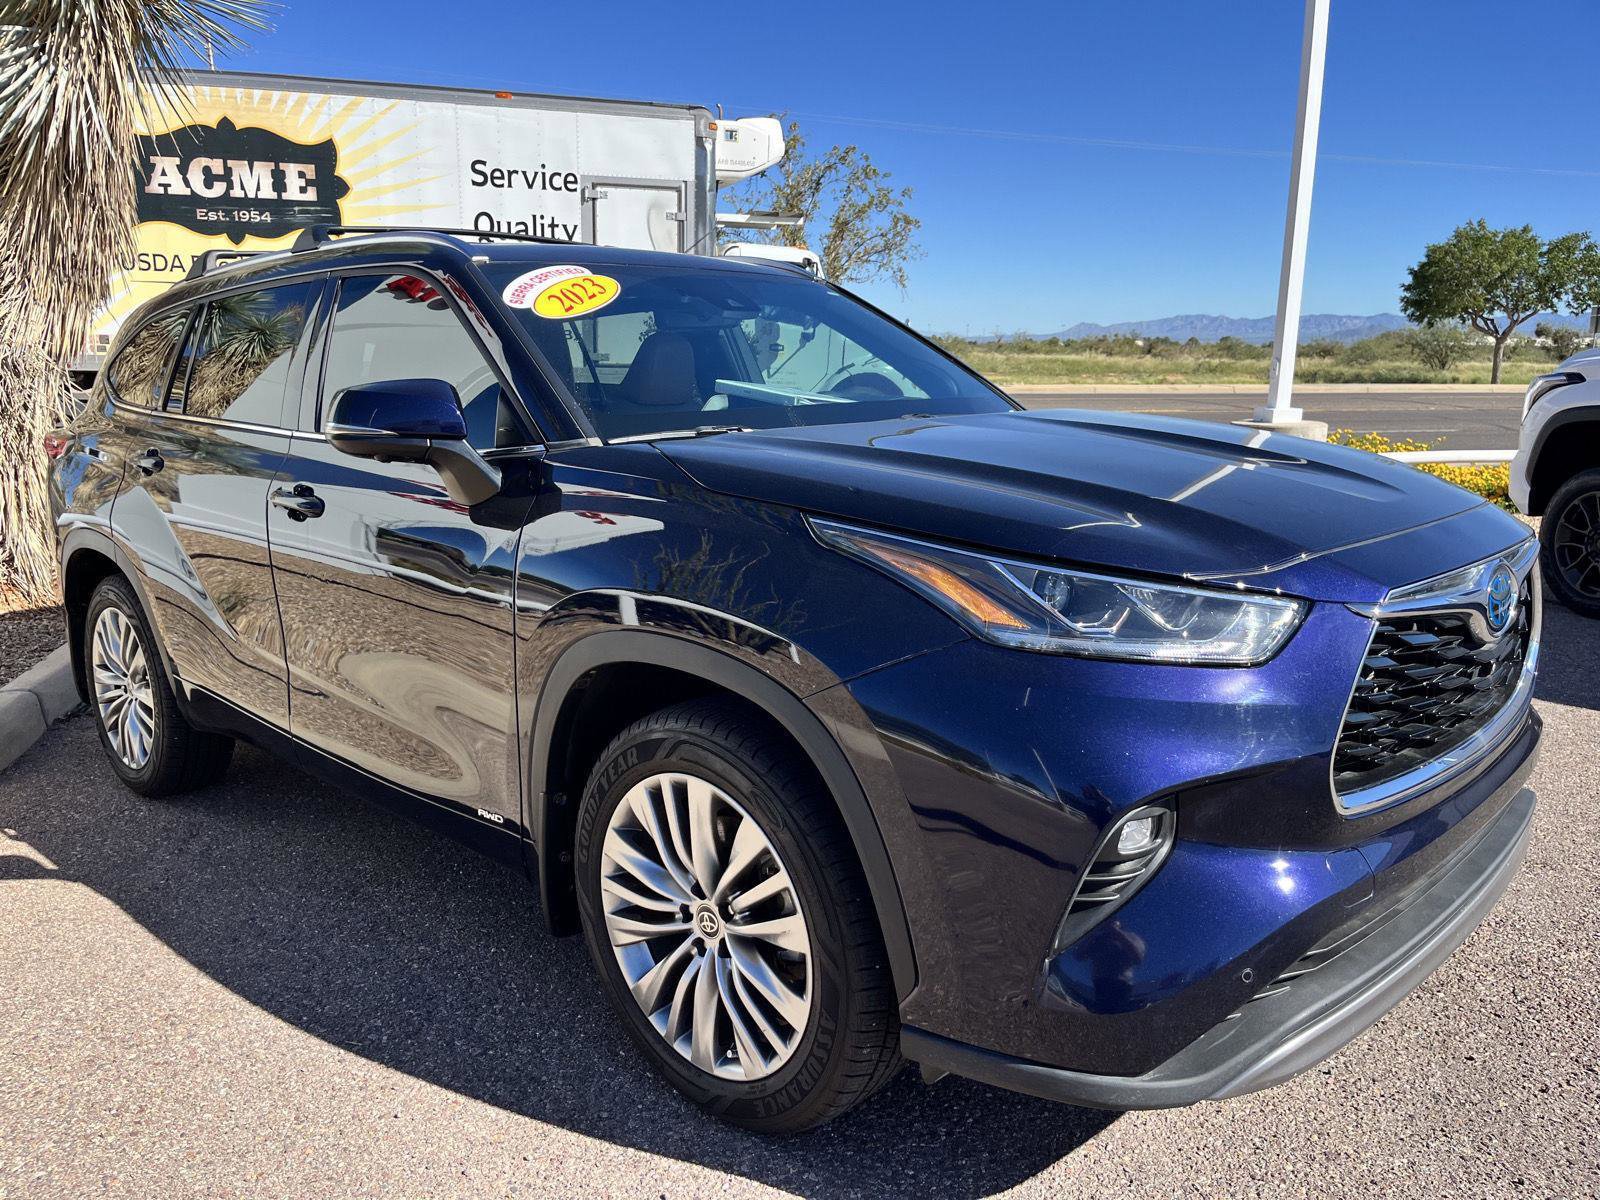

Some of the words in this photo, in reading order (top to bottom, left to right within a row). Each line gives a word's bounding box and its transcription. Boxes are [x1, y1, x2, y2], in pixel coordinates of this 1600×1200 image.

[144, 156, 318, 201] ACME
[470, 159, 578, 192] Service
[196, 208, 229, 221] Est.
[232, 210, 272, 223] 1954
[121, 252, 186, 273] USDA
[509, 282, 537, 305] SIERRA
[529, 267, 585, 284] CERTIFIED
[547, 277, 607, 312] 2023
[477, 808, 504, 824] AWD
